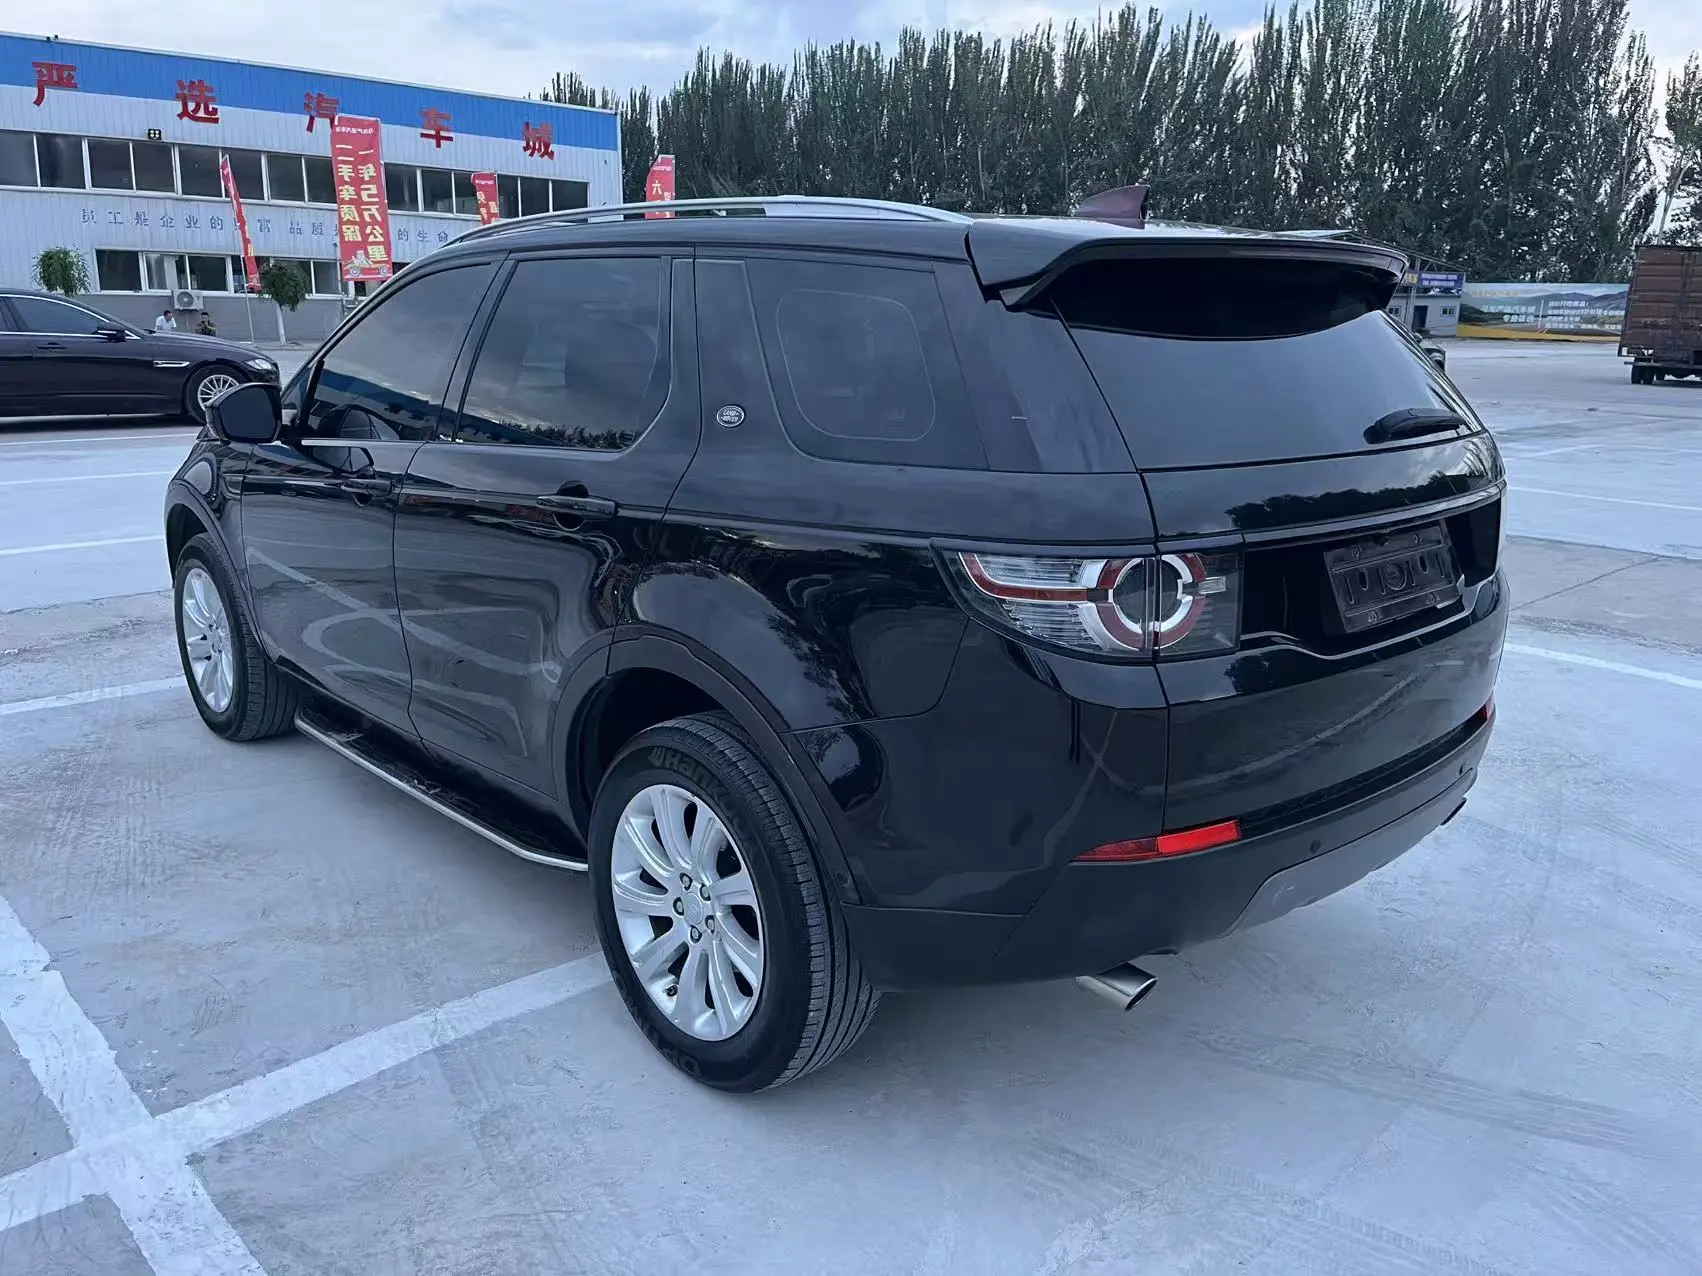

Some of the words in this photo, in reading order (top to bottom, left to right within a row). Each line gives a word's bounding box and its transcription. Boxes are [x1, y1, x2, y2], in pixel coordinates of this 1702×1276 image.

[32, 61, 554, 160] 严选汽车城
